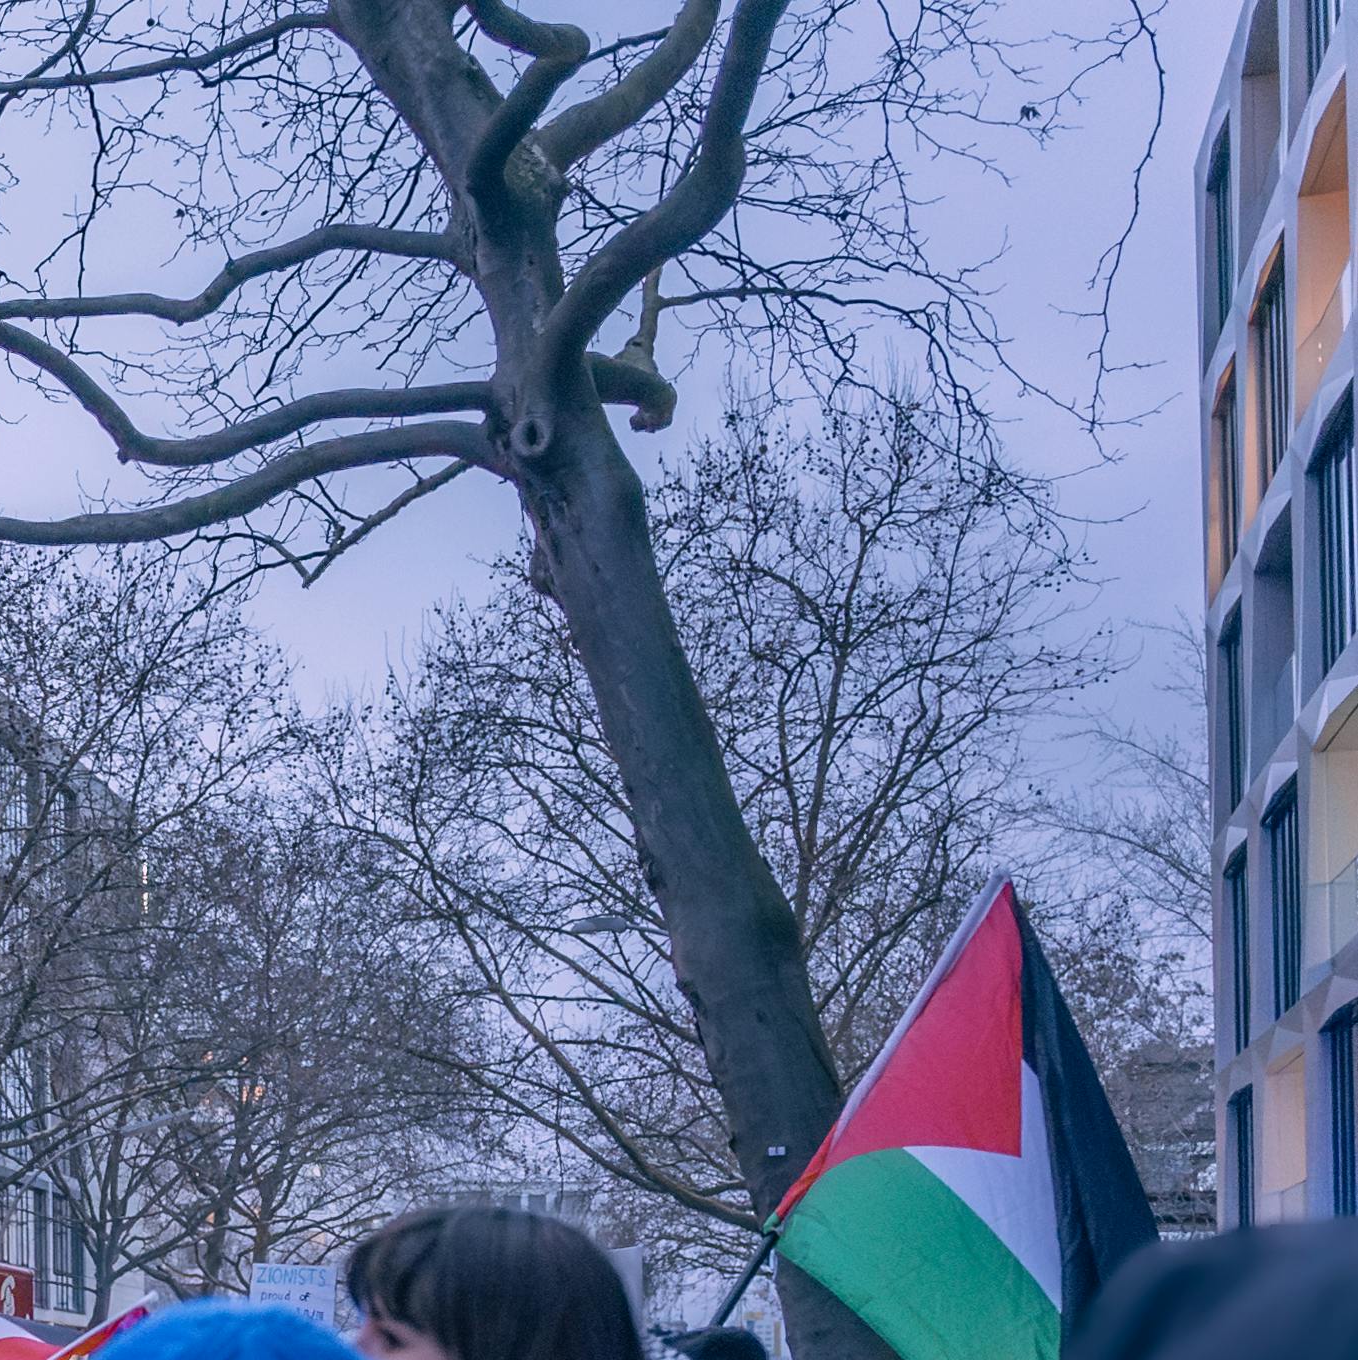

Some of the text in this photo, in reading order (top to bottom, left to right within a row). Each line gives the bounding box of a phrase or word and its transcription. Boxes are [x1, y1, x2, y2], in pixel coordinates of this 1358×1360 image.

[256, 1266, 327, 1287] ZIONISTS
[260, 1289, 311, 1304] proud of
